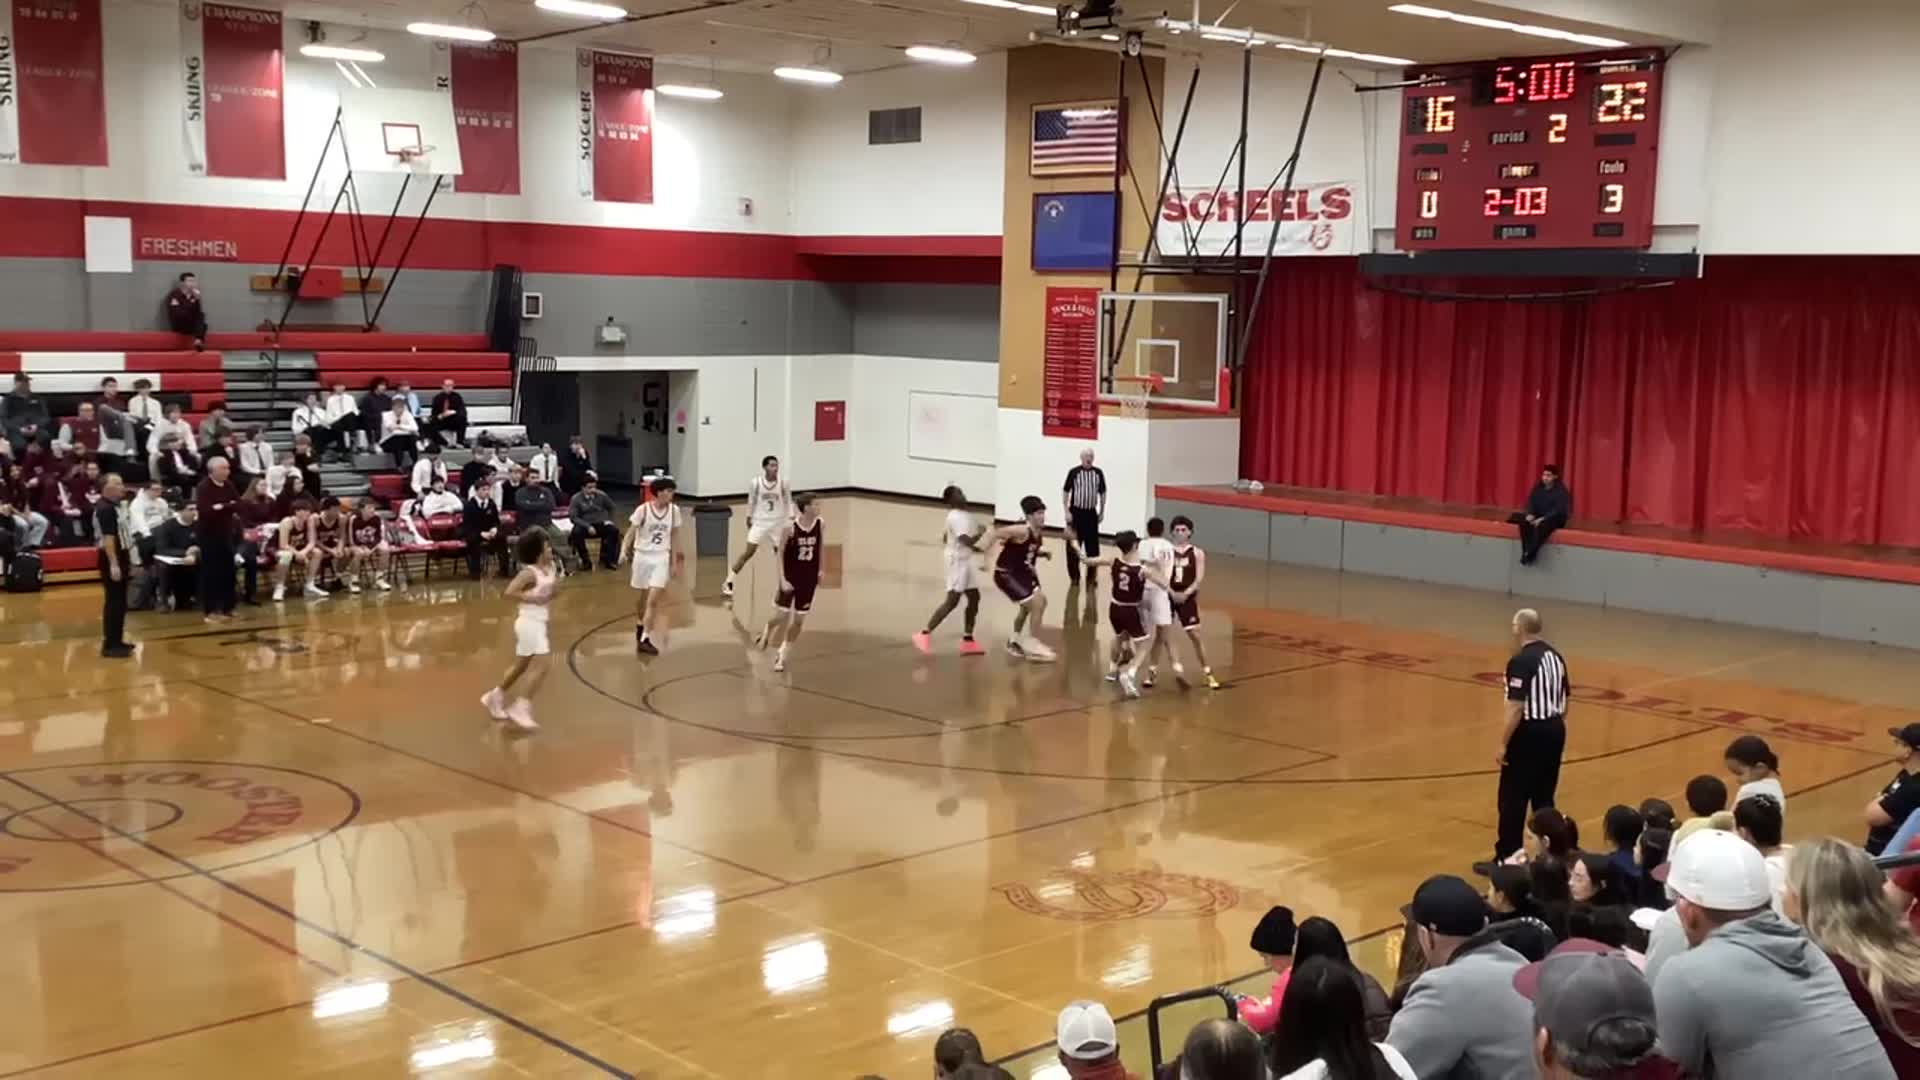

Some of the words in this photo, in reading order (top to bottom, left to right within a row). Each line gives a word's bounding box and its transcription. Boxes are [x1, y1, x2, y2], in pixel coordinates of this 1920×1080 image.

[186, 56, 201, 121] SKIING
[1494, 61, 1575, 103] 5:00
[581, 90, 592, 160] SOCCER
[1426, 96, 1456, 132] 16
[1548, 114, 1568, 143] 2
[1162, 187, 1352, 222] SCHEELS
[1604, 184, 1624, 213] 3
[141, 238, 238, 257] FRESHMEN
[1119, 572, 1130, 591] 2
